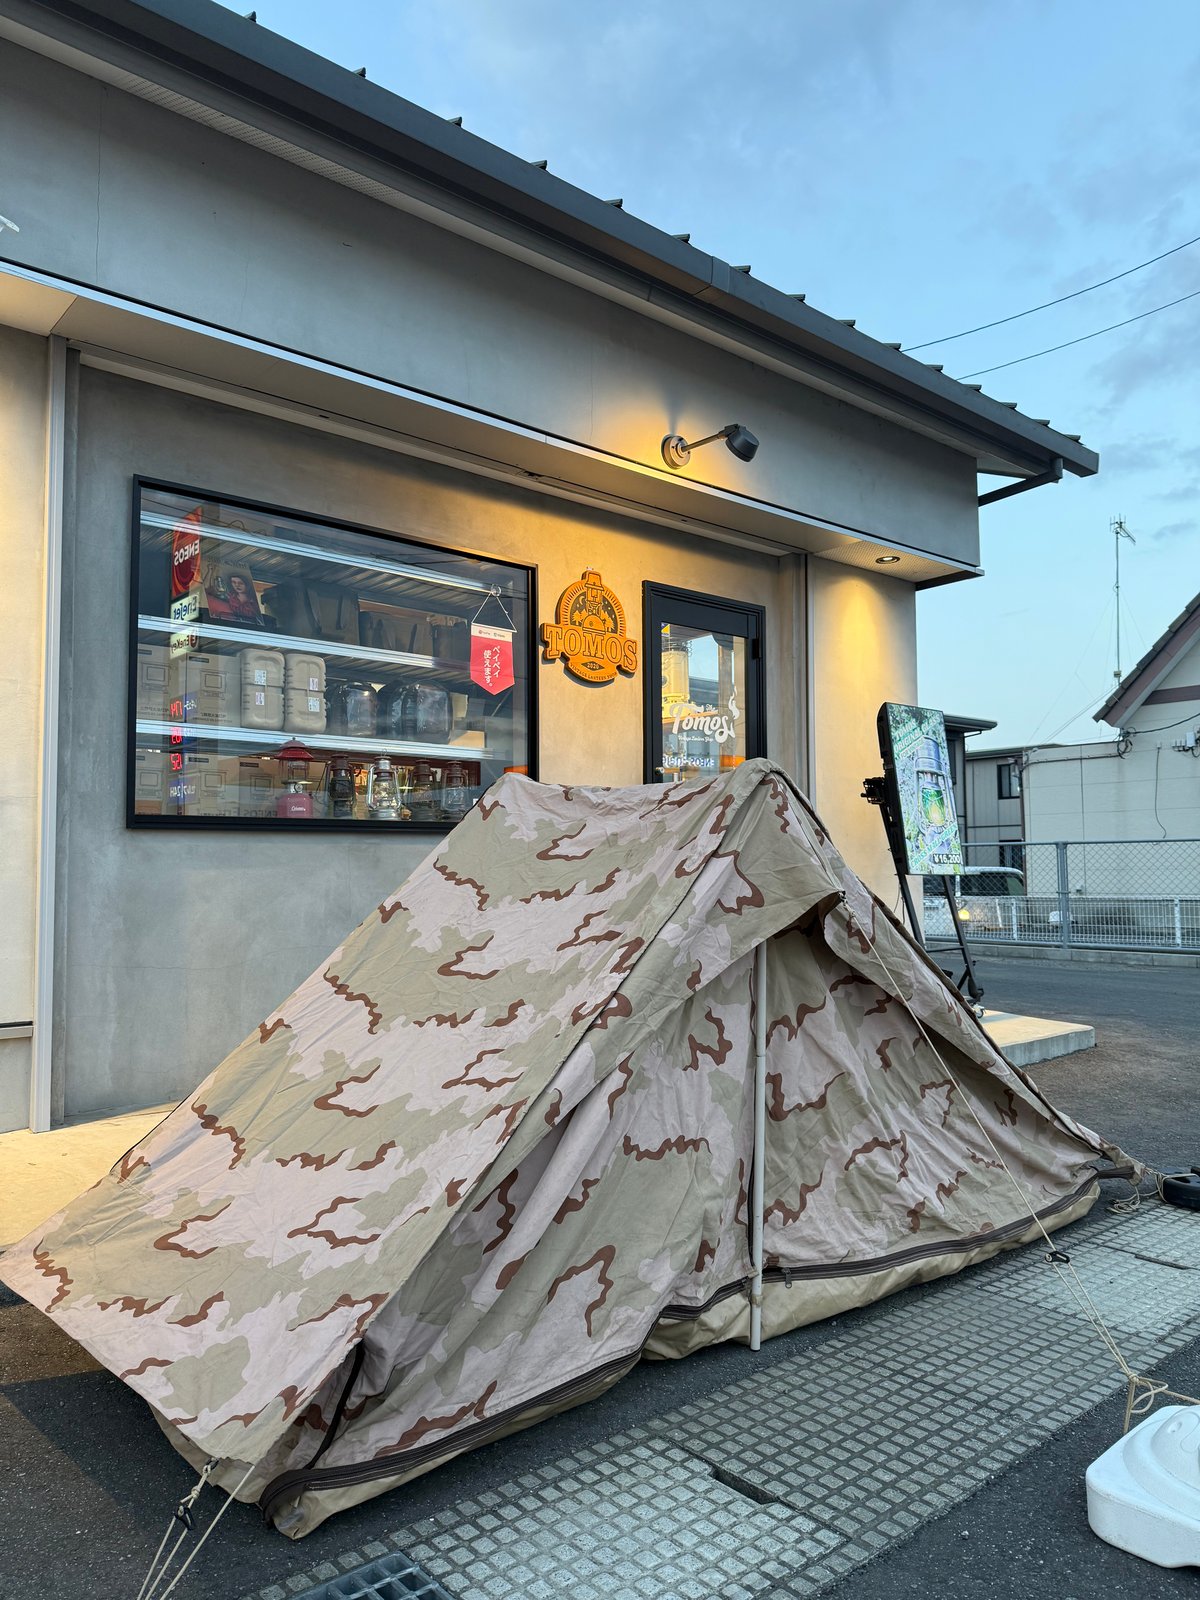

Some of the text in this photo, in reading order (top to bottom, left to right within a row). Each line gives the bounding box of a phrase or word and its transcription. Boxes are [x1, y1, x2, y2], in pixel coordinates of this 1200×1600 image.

[493, 645, 501, 678] ペイペイ
[546, 624, 637, 672] TOMOS
[483, 649, 493, 687] 使えます。
[670, 703, 736, 743] Tomos
